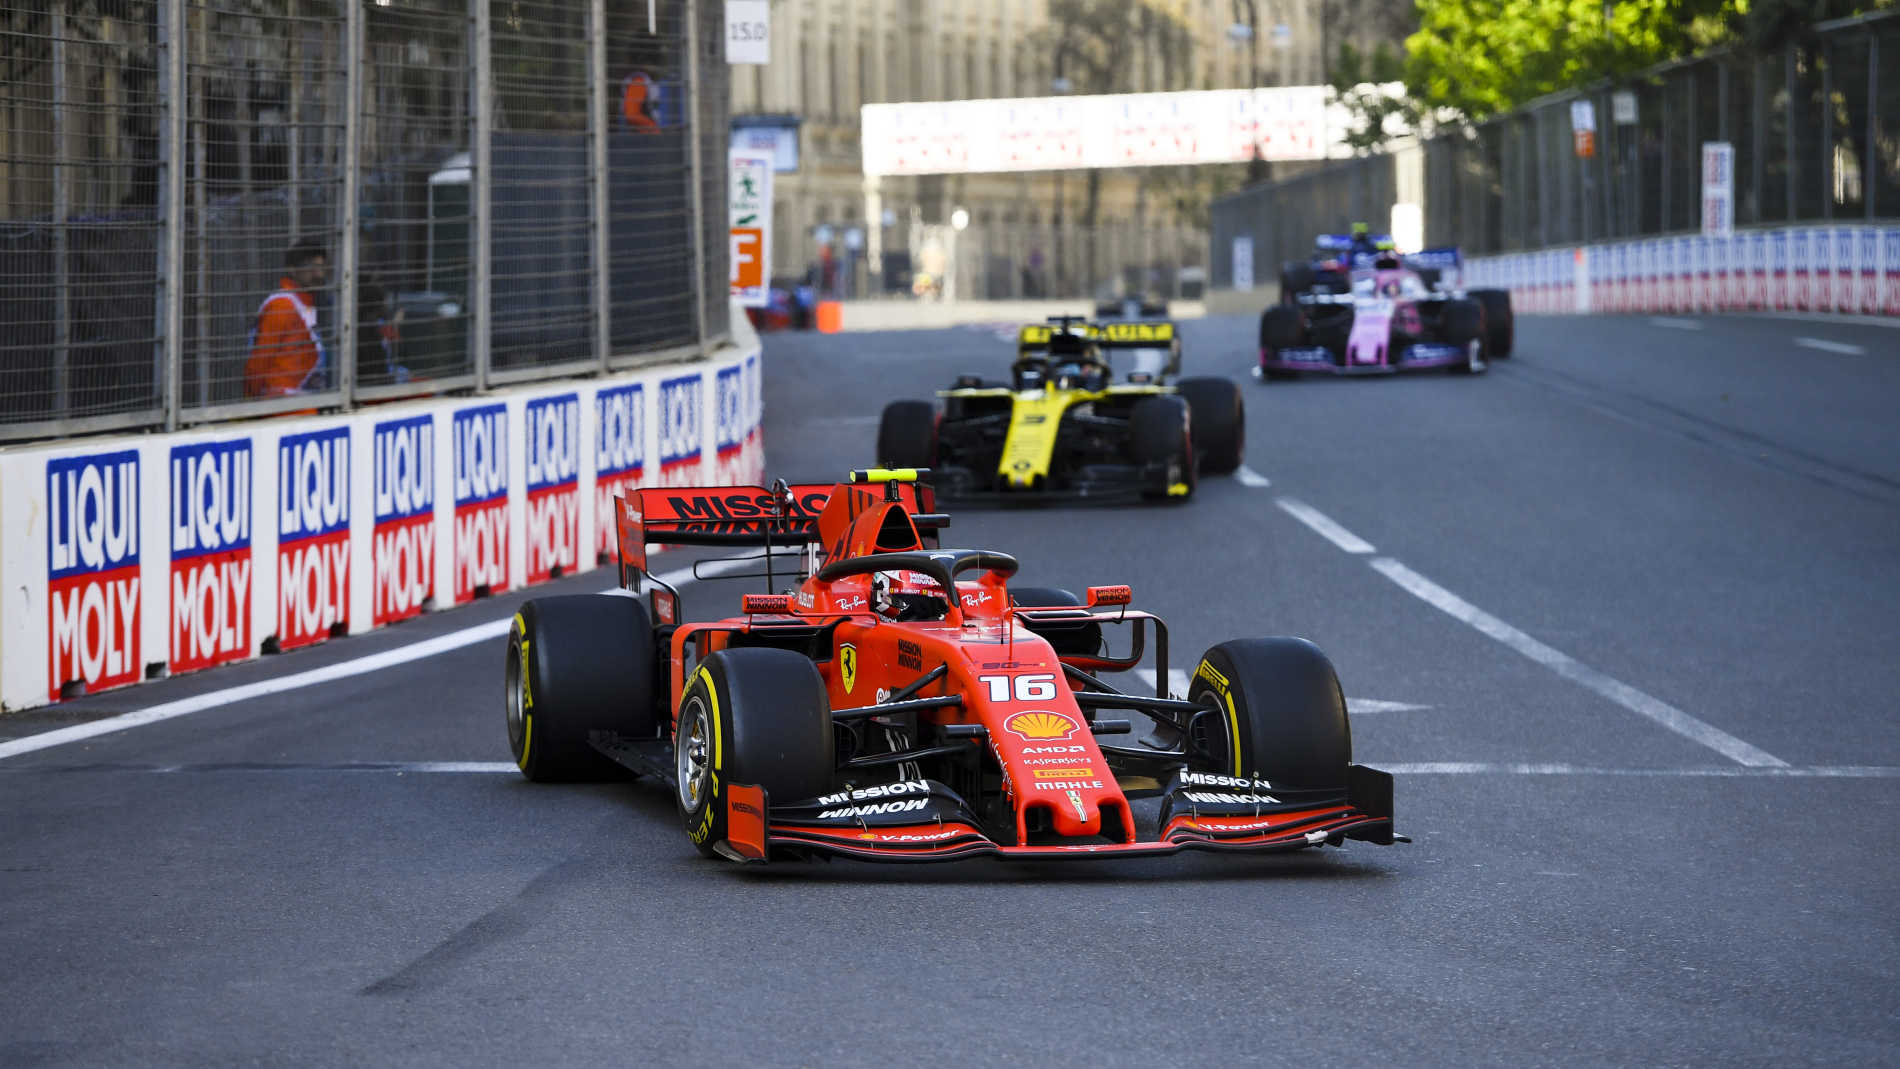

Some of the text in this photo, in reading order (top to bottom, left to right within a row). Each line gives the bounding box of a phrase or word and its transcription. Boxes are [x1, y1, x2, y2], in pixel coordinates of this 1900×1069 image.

[729, 233, 758, 282] F
[376, 423, 432, 516] LIQUI
[455, 411, 506, 501] LIQUI
[527, 400, 578, 484] LIQUI
[51, 461, 137, 571] LIQUI
[172, 449, 249, 552] LIQUI
[281, 437, 348, 535] LIQUI
[375, 520, 434, 616] MOLY
[455, 503, 508, 597] MOLY
[527, 490, 578, 577] MOLY
[173, 558, 251, 663] MOLY
[281, 540, 349, 640] MOLY
[835, 595, 868, 612] Ray-Ban
[52, 577, 139, 690] MOLY
[978, 673, 1057, 702] 16
[1022, 745, 1069, 755] AMD
[1035, 780, 1104, 790] MAHLE
[1179, 770, 1272, 791] MISSION
[817, 780, 930, 806] MISSION
[817, 797, 930, 819] WINNOW
[881, 829, 960, 842] V-Power
[1182, 791, 1283, 804] WINNOW
